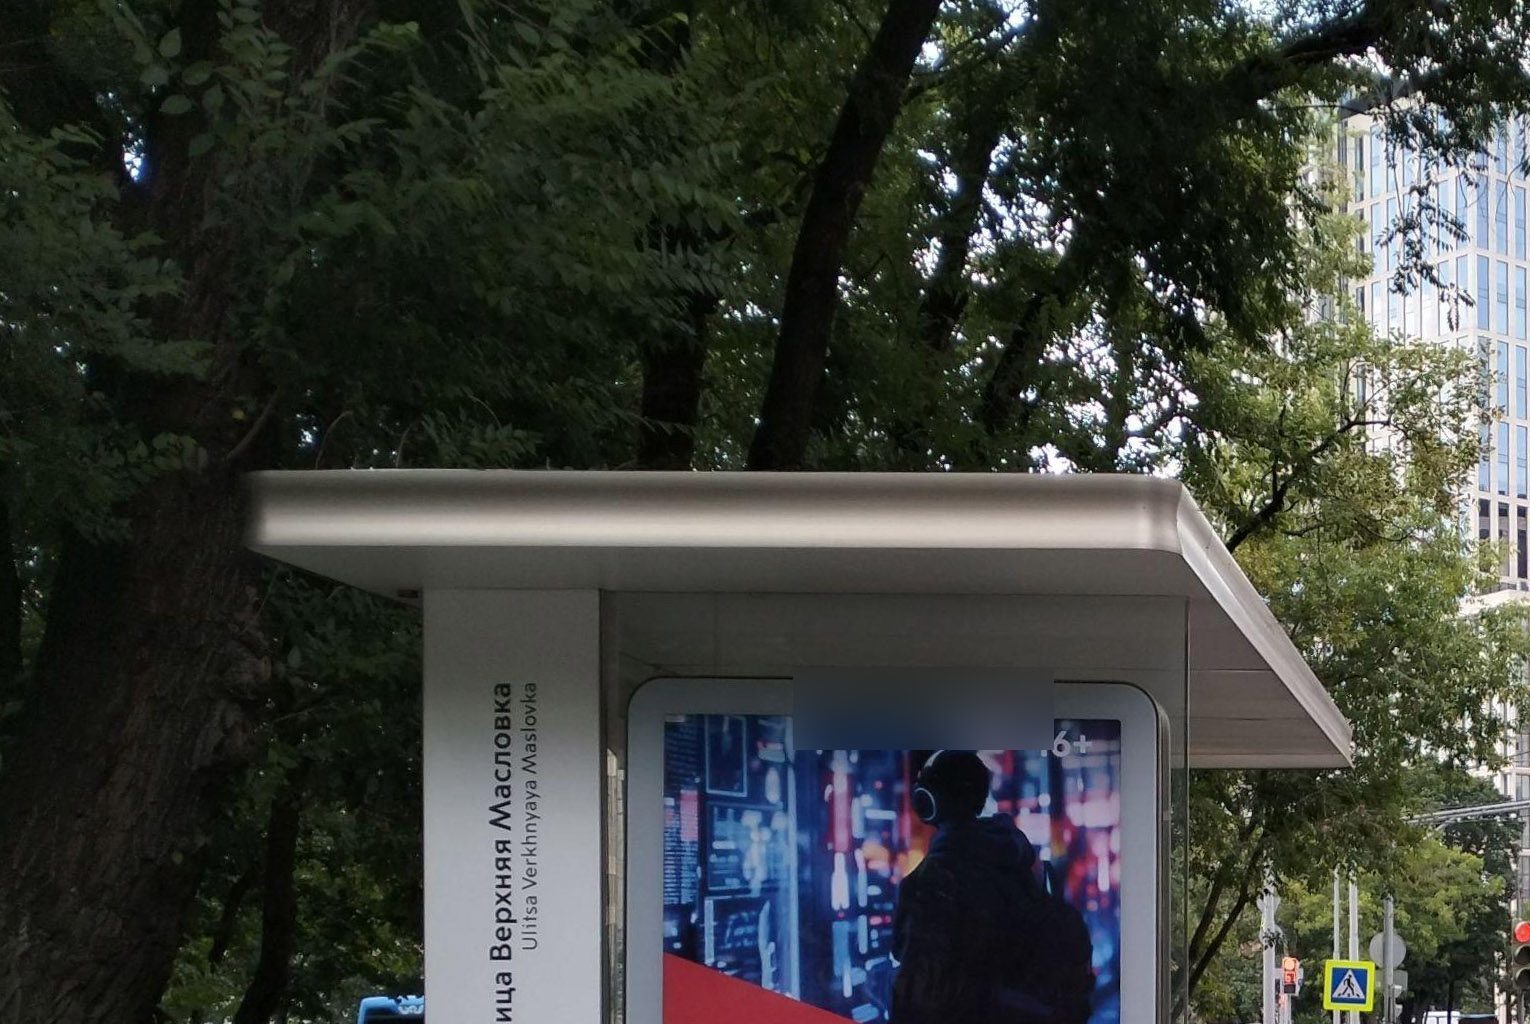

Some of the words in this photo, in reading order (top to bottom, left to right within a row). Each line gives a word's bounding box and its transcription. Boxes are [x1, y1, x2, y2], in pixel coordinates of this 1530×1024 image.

[488, 682, 513, 832] Масловка
[520, 682, 538, 775] Maslovka
[1052, 730, 1092, 758] 6+
[520, 779, 541, 889] Verkhnyaya
[489, 839, 517, 961] Верхняя
[521, 896, 538, 951] Ulitsa
